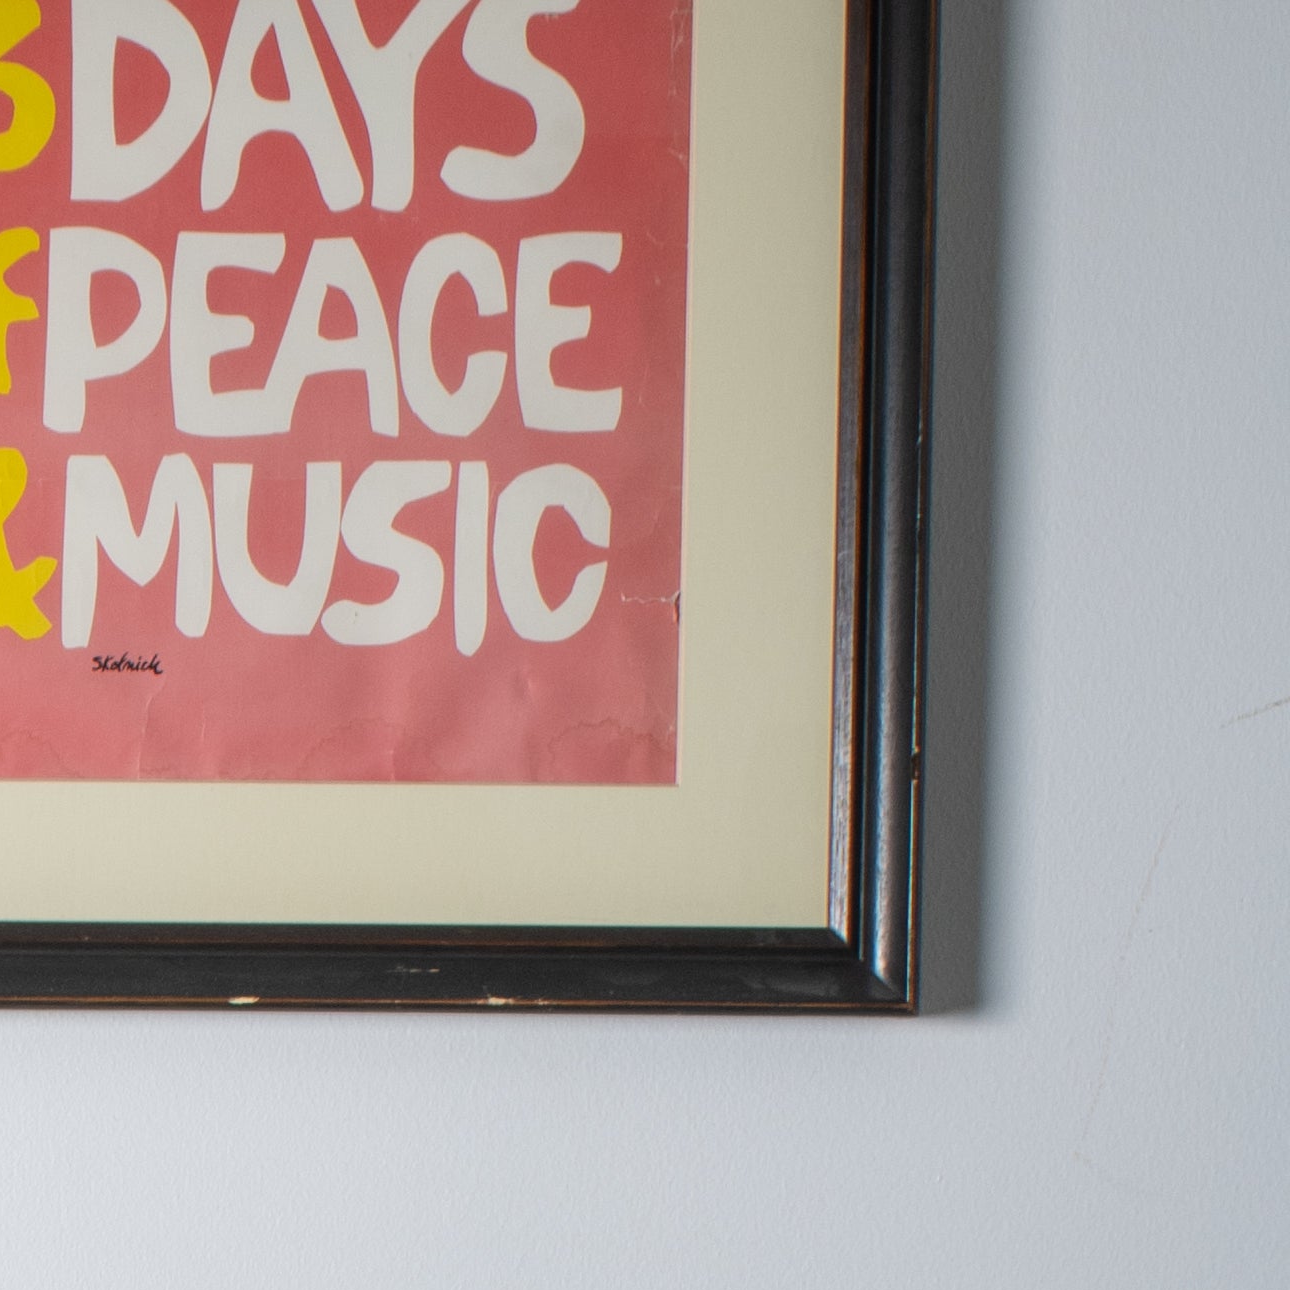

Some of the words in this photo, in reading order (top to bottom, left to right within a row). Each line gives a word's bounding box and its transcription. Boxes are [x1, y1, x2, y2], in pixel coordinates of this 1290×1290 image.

[70, 0, 586, 212] DAYS
[43, 226, 623, 437] PEACE
[62, 454, 612, 657] MUSIC
